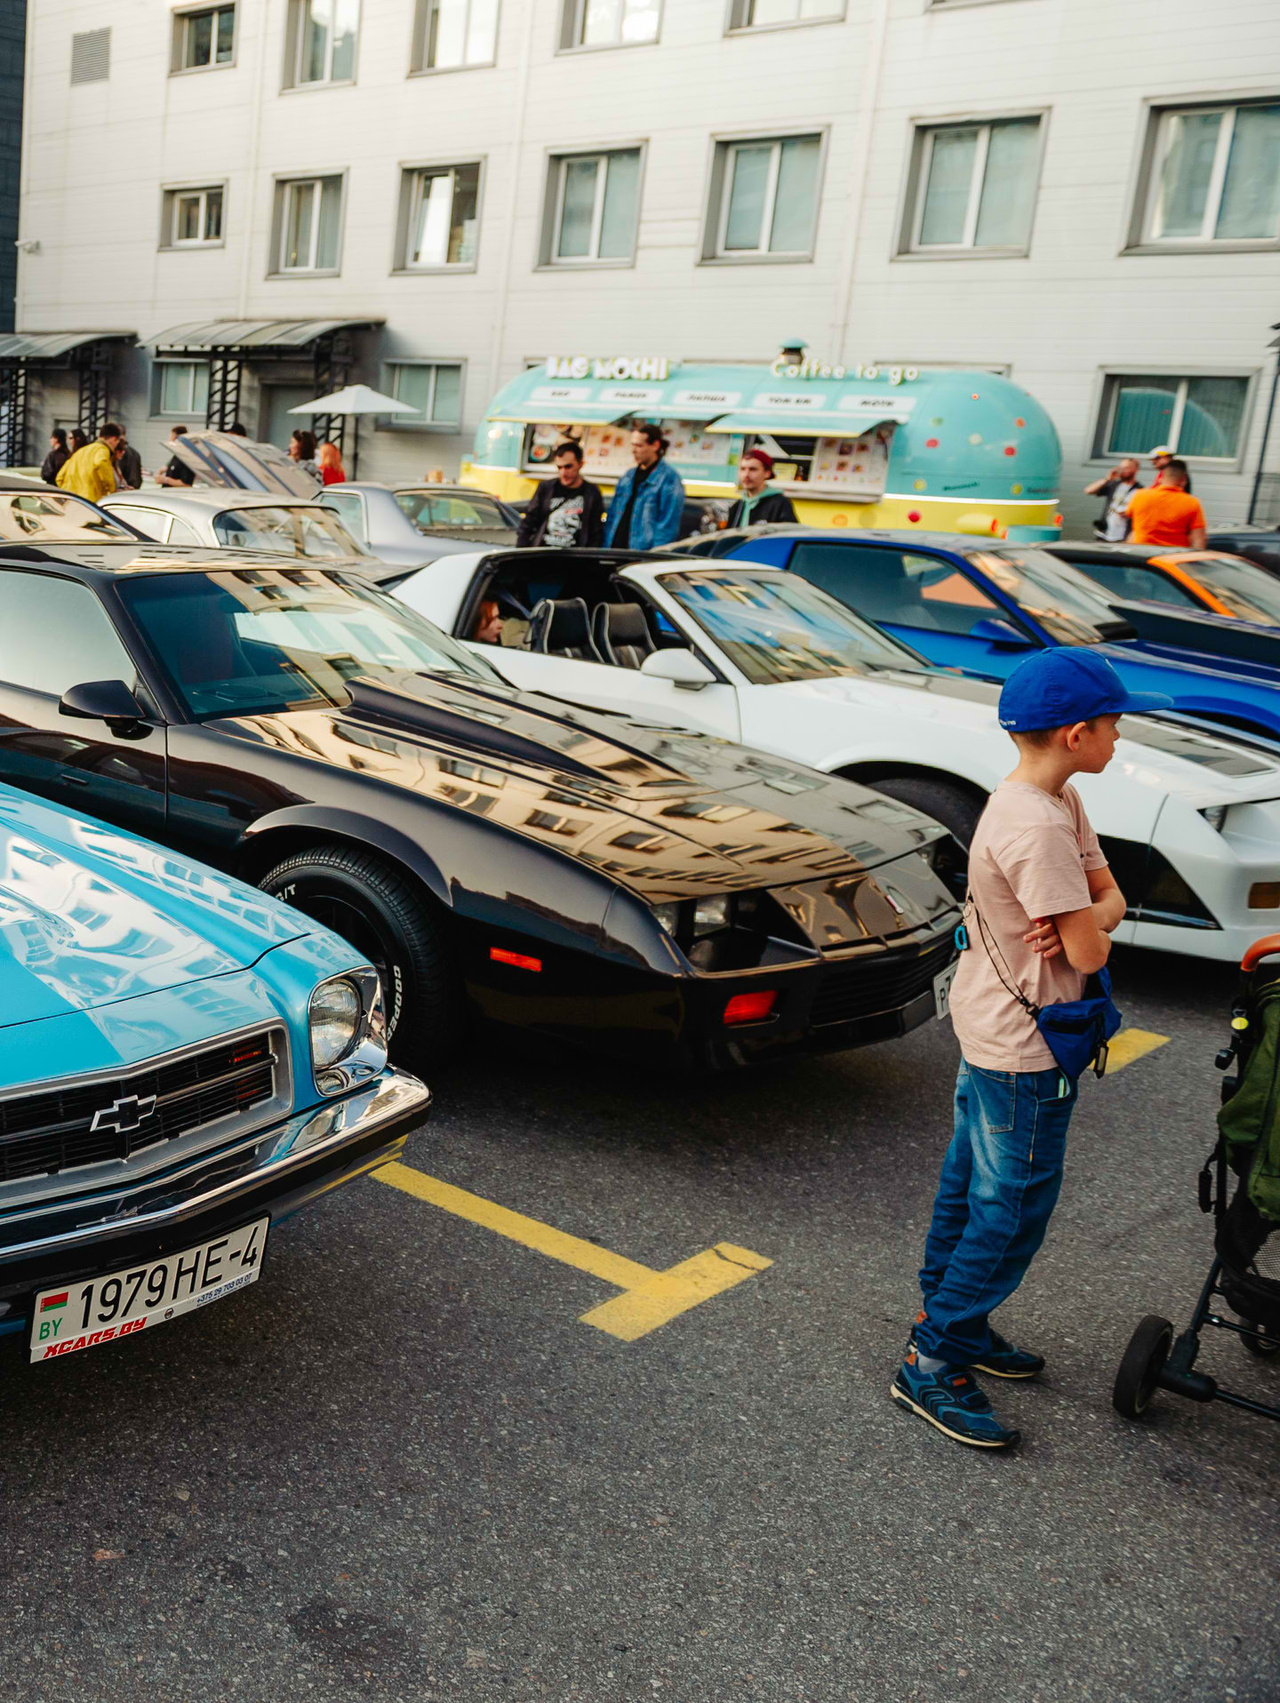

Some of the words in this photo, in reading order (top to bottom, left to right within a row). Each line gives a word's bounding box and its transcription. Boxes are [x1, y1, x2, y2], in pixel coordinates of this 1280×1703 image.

[593, 356, 670, 381] MOCHI
[771, 357, 847, 380] Coffee
[855, 362, 879, 380] to
[888, 366, 919, 386] go
[387, 964, 403, 1042] COOPER
[196, 1290, 213, 1304] +375
[214, 1287, 223, 1297] 29
[223, 1280, 235, 1291] 703
[236, 1276, 244, 1286] 03
[244, 1272, 253, 1282] 07
[39, 1317, 64, 1341] BY
